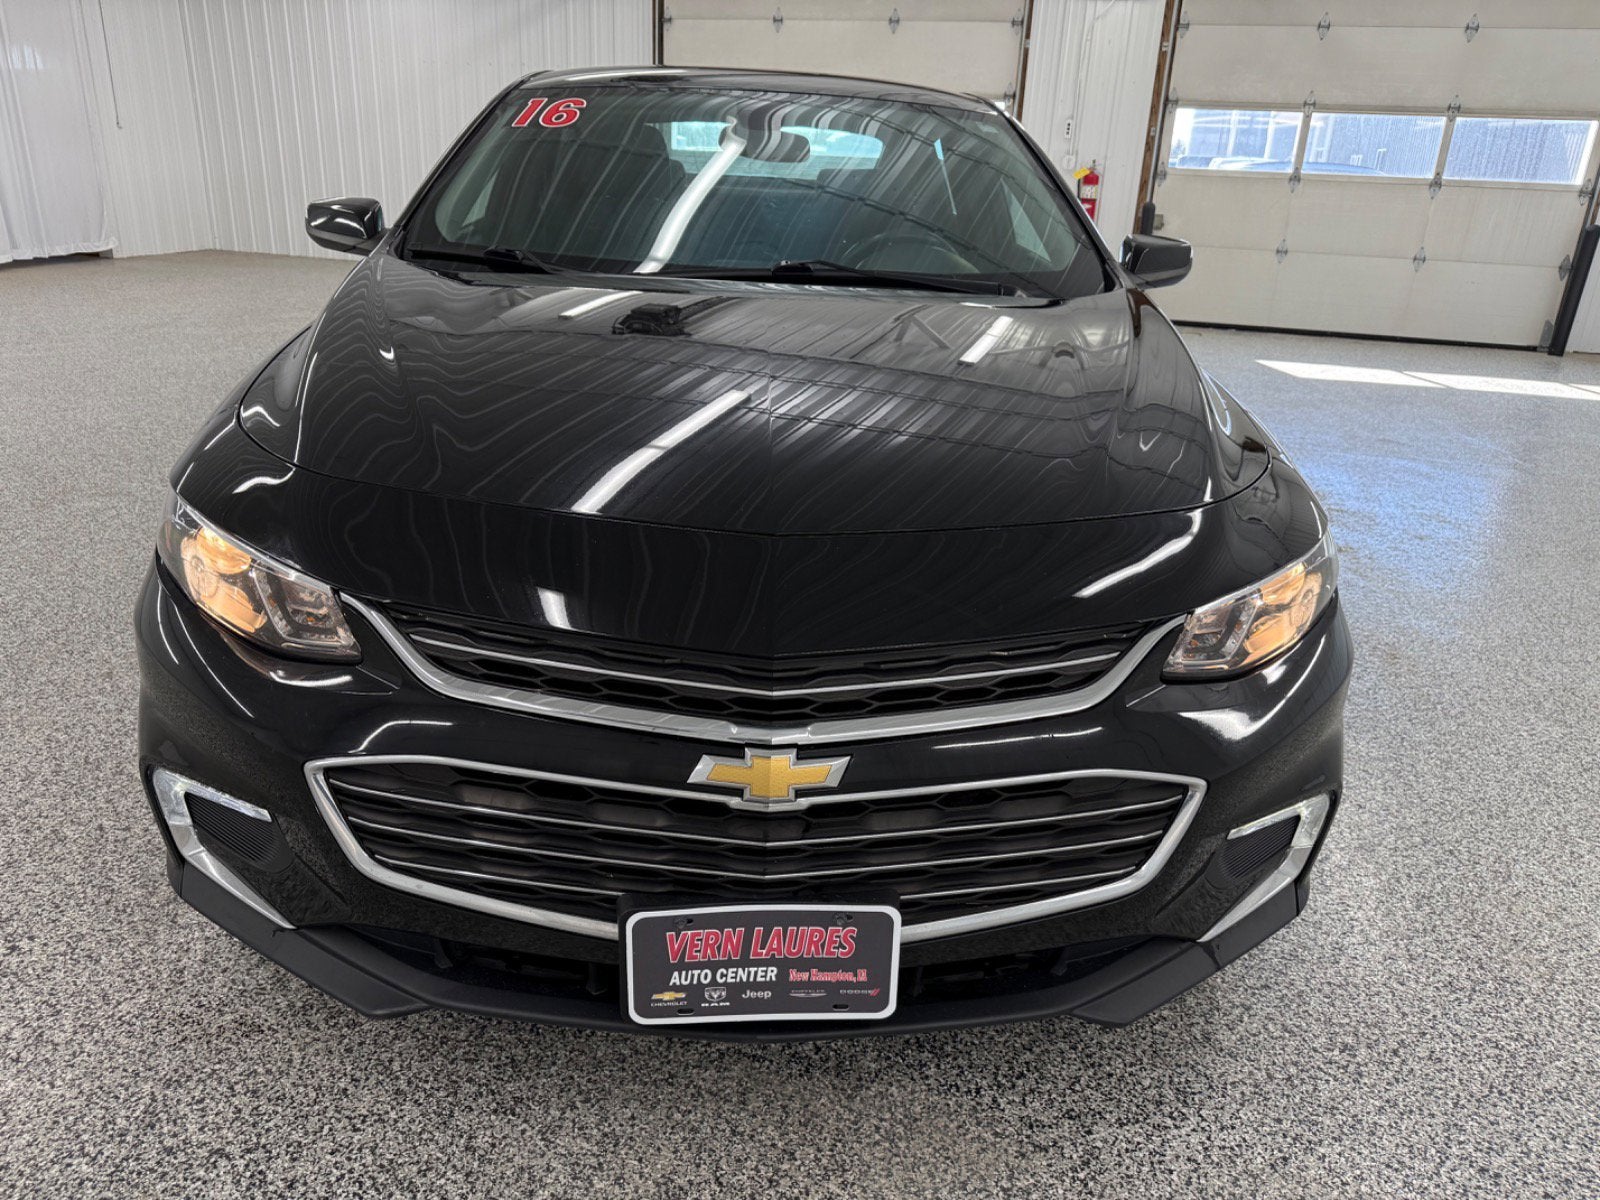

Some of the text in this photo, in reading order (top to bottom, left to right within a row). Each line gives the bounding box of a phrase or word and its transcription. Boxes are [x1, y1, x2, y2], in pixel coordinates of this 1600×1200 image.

[511, 97, 587, 128] 16
[666, 927, 857, 963] VERN LAURES
[669, 967, 777, 986] AUTO CENTER
[789, 968, 809, 981] New
[810, 969, 857, 982] Hampton,
[742, 989, 772, 999] Jeep
